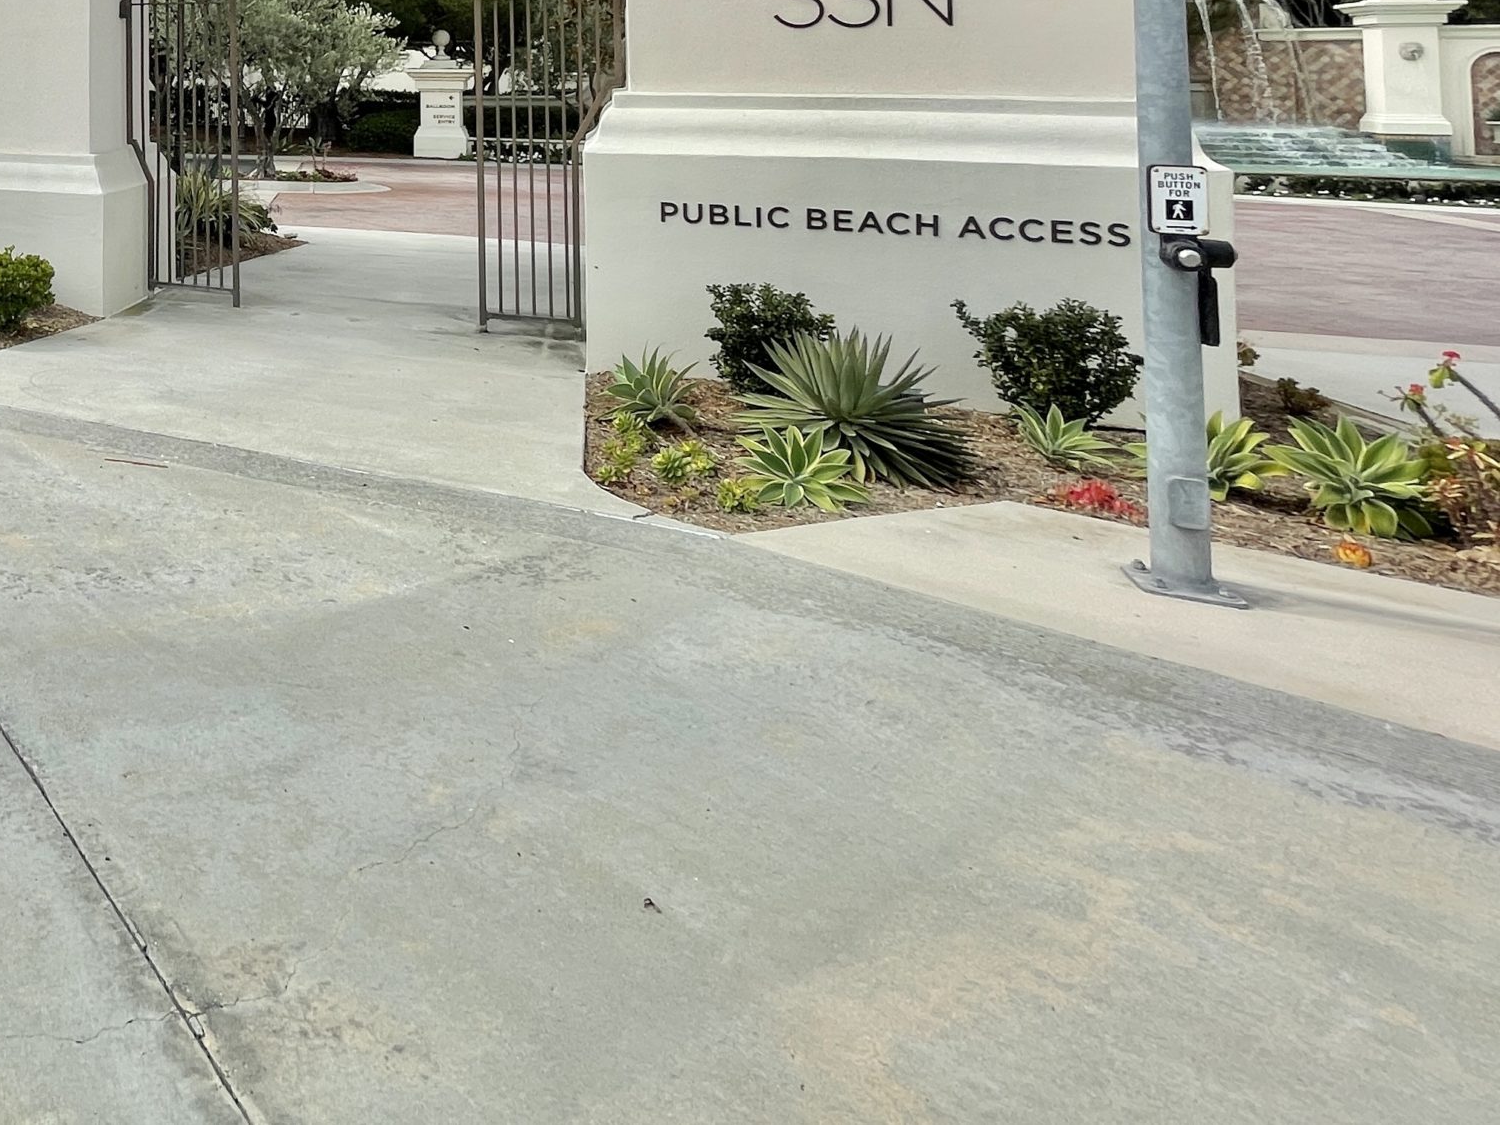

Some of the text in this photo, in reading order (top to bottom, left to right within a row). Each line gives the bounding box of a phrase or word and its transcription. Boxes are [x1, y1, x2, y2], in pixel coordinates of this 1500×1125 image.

[1163, 172, 1193, 180] PUSH
[1157, 180, 1201, 189] BUTTON
[1169, 189, 1190, 197] FOR
[660, 201, 1132, 247] PUBLIC BEACH ACCESS
